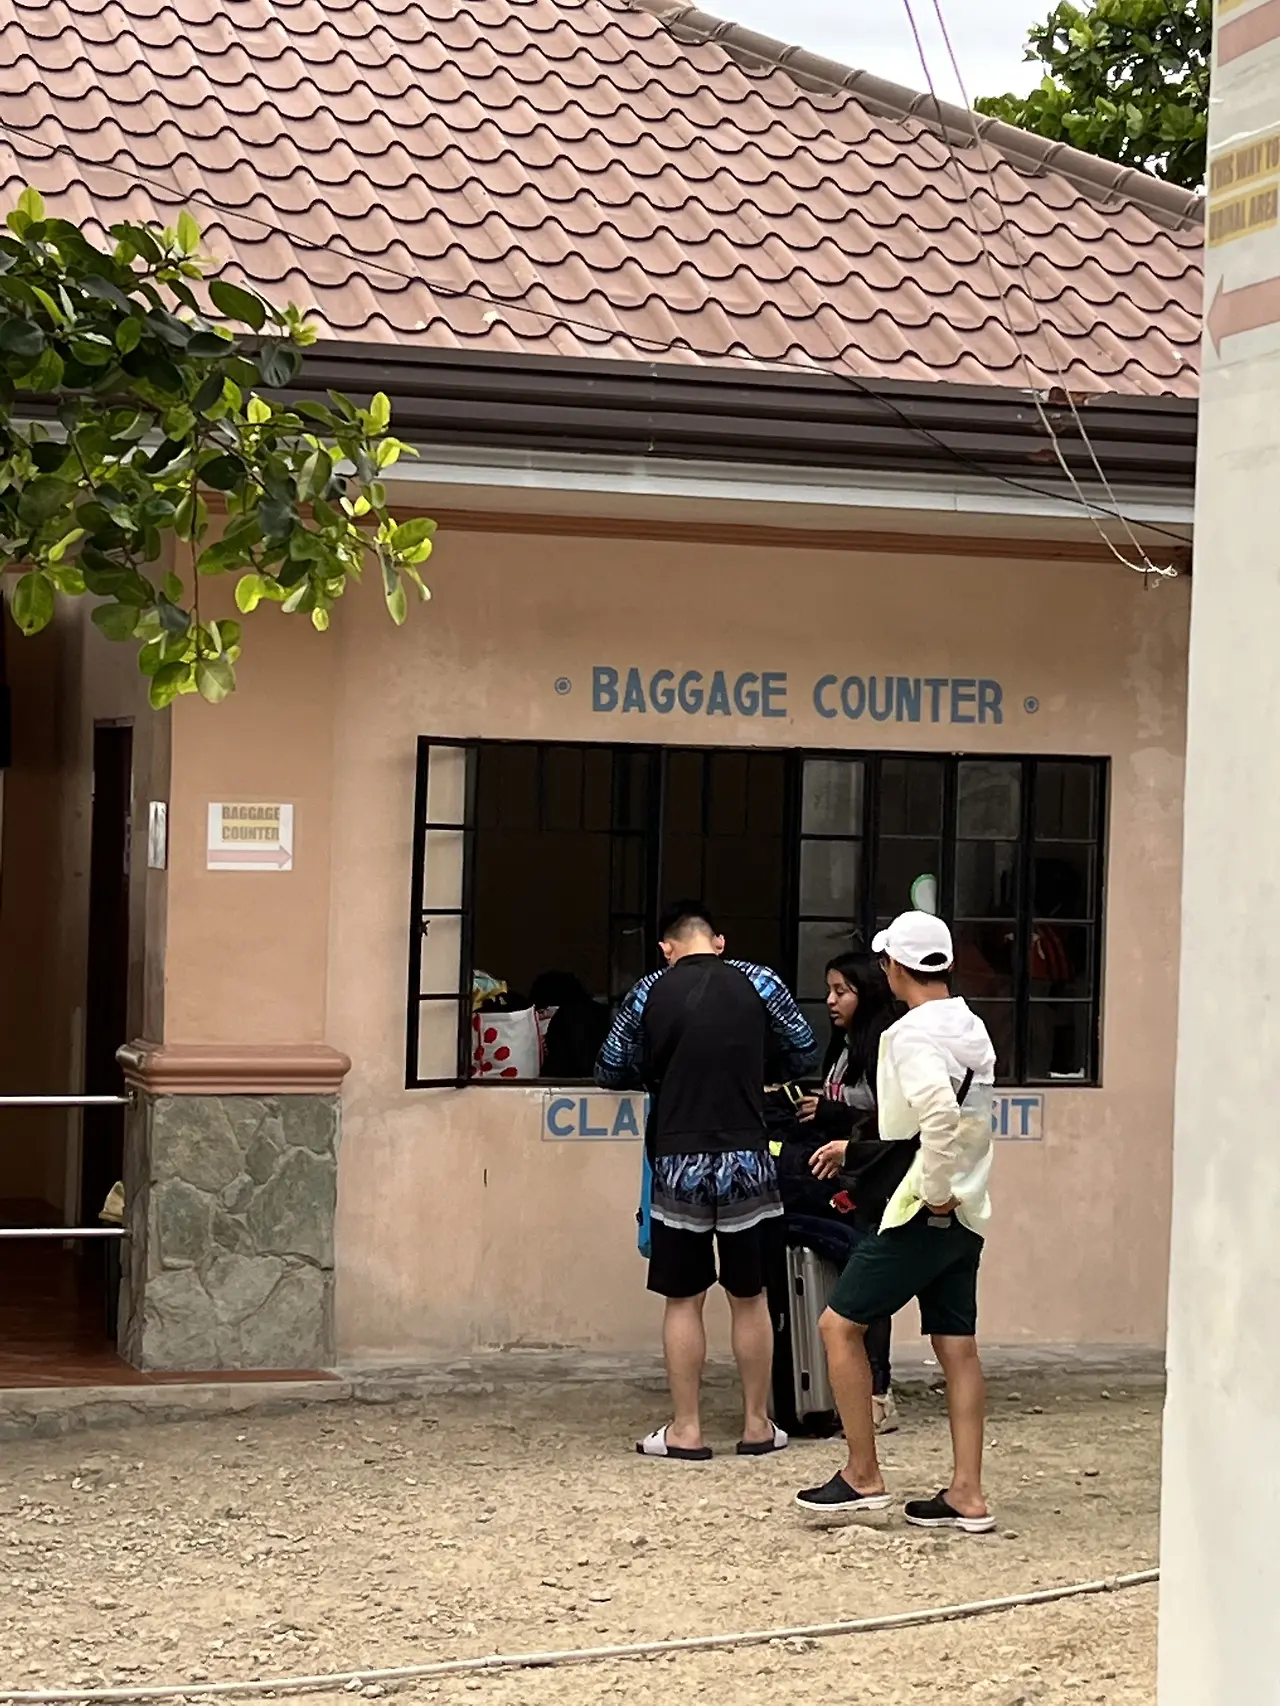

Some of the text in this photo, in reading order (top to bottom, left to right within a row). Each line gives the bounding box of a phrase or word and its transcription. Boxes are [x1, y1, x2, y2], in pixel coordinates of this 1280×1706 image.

[592, 666, 1003, 725] BAGGAGE COUNTER
[222, 805, 280, 820] BAGGAGE
[222, 826, 280, 841] COUNTER
